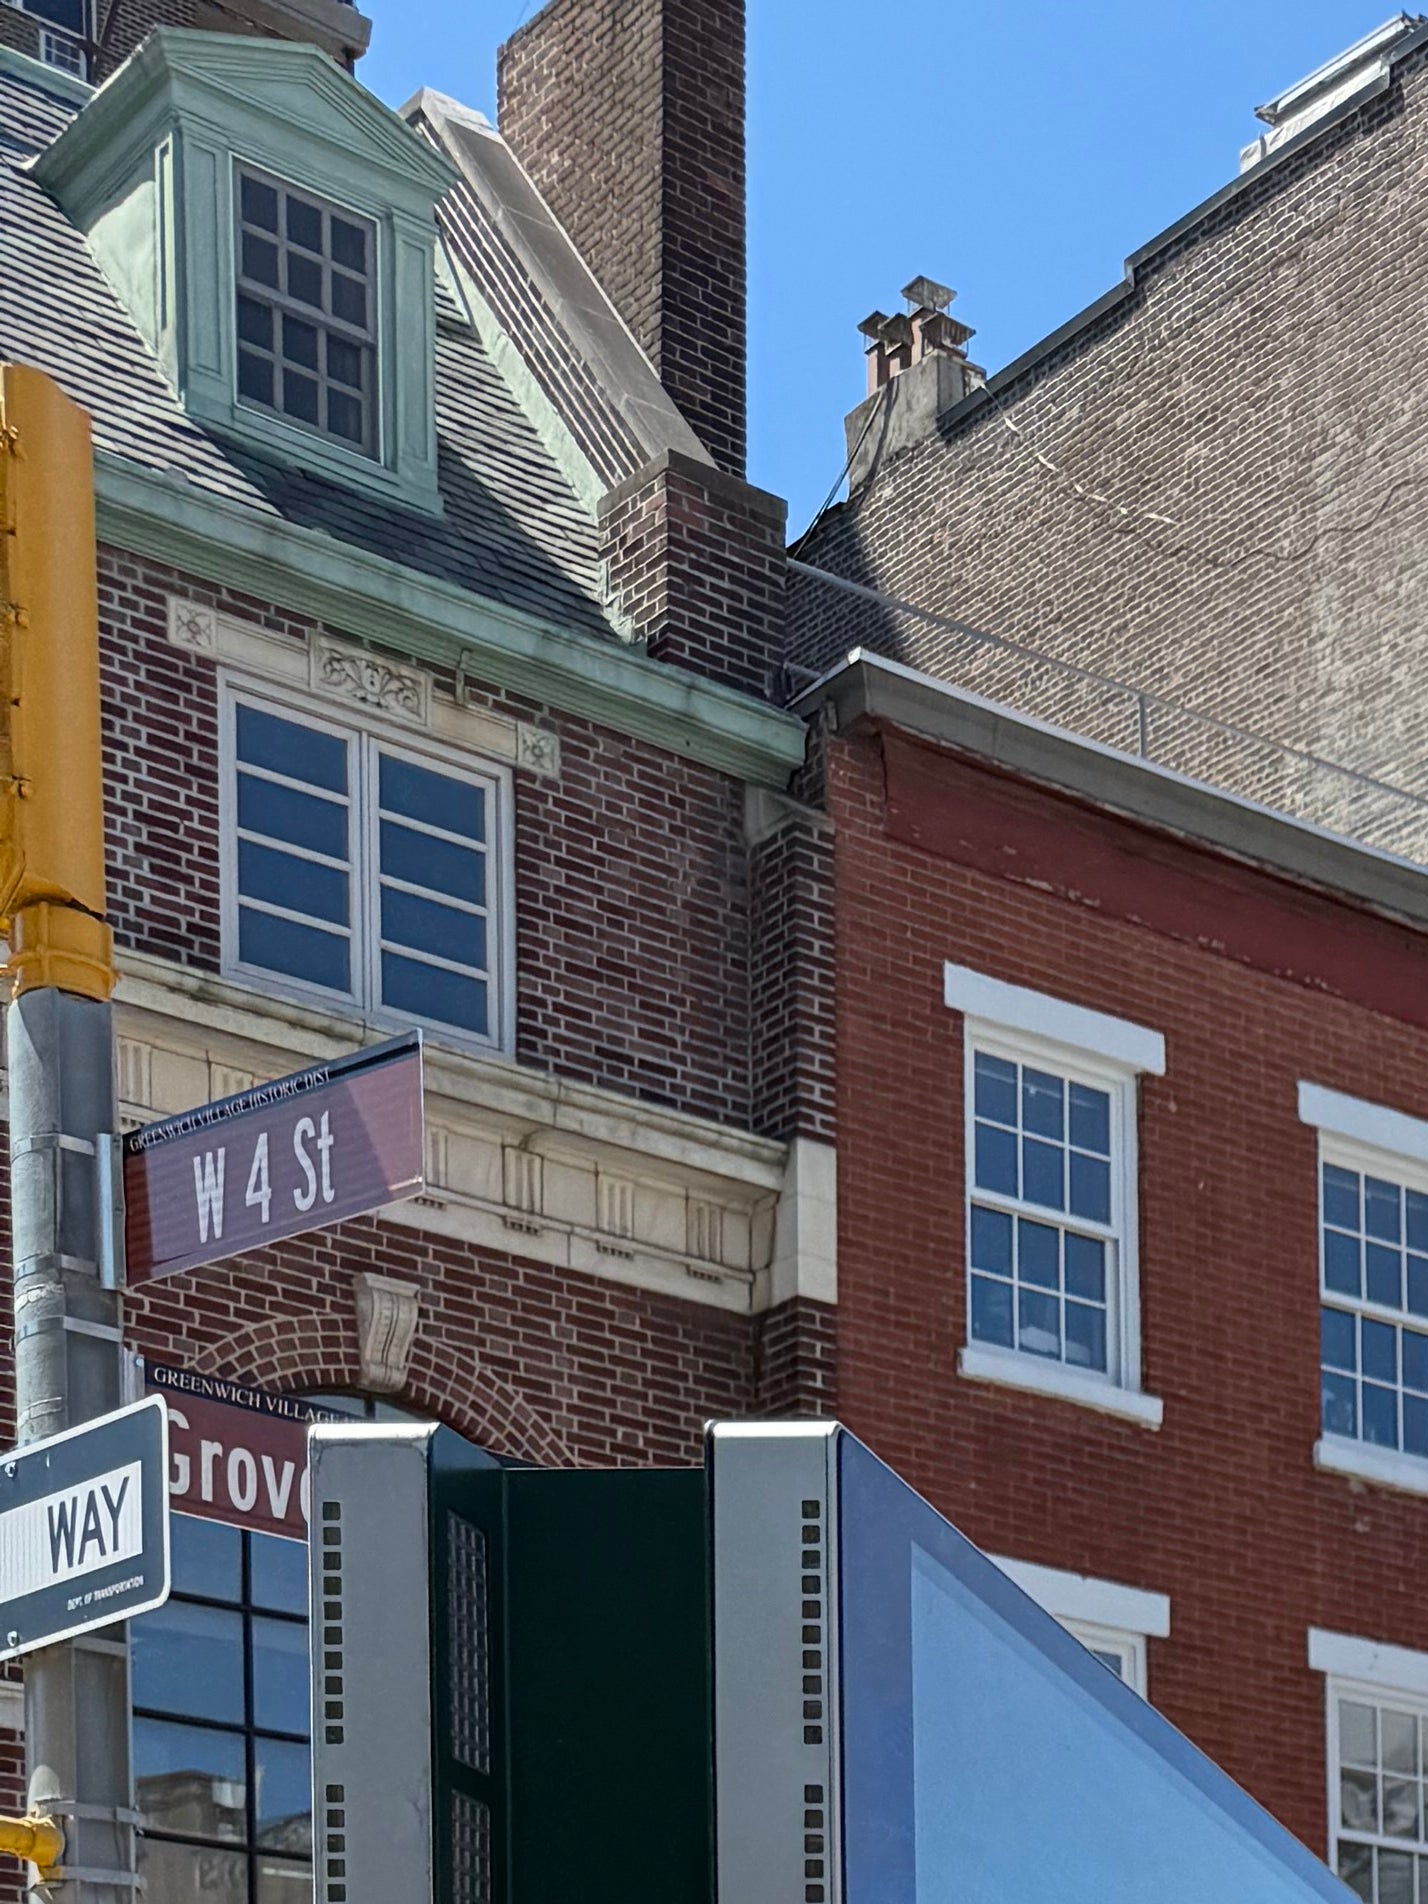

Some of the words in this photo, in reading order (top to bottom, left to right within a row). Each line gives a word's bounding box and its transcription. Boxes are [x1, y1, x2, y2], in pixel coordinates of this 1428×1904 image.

[129, 1115, 197, 1152] GREENWICH
[197, 1094, 248, 1131] VILLAGE
[249, 1076, 304, 1110] HISTORIC
[304, 1066, 331, 1088] DIST
[193, 1147, 226, 1244] W
[245, 1132, 271, 1224] 4
[293, 1110, 334, 1212] St
[154, 1367, 260, 1408] GREENWICH
[168, 1408, 309, 1523] Grov
[48, 1476, 129, 1574] WAY
